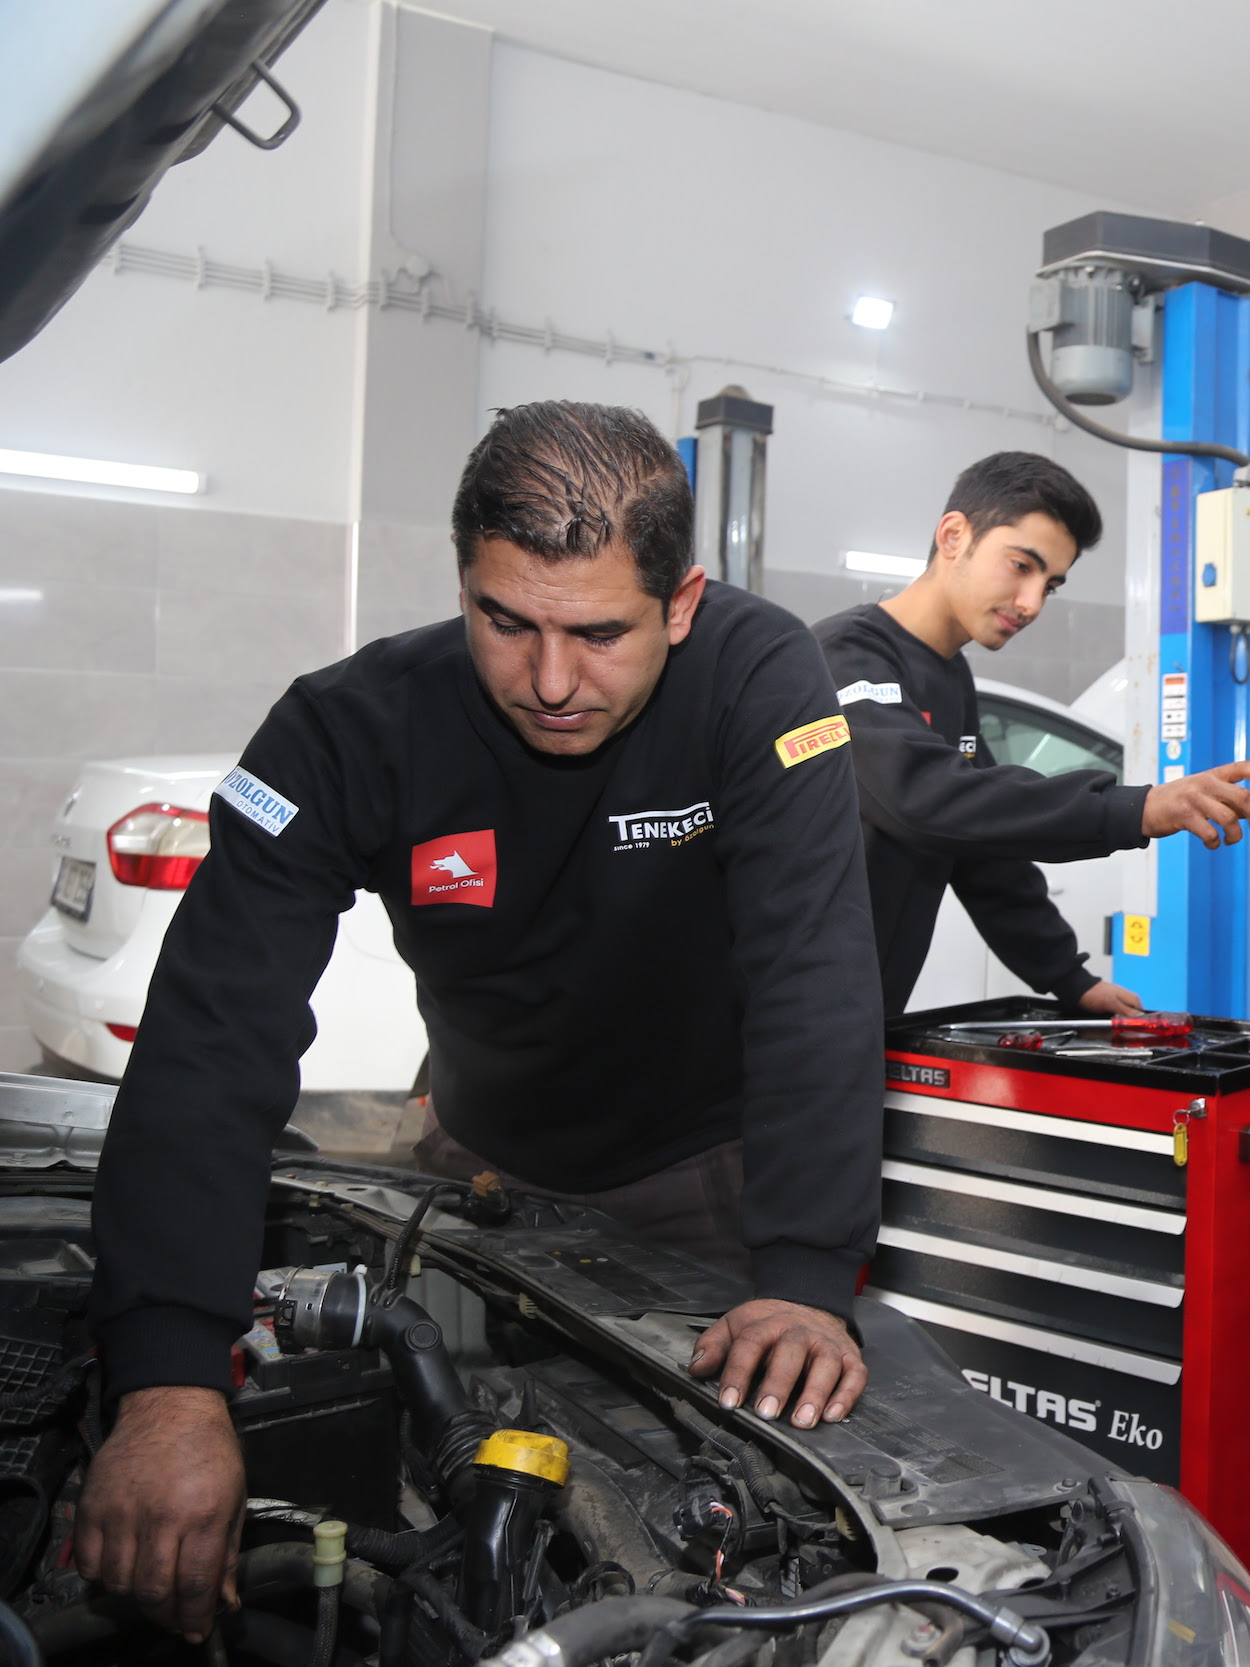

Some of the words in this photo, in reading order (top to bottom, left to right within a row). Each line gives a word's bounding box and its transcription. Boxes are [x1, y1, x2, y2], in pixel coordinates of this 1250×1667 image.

[783, 720, 851, 759] PIRELLI
[613, 843, 633, 852] since
[670, 839, 682, 847] by
[428, 882, 459, 893] Petrol
[460, 878, 484, 887] Ofisi
[961, 1368, 1097, 1432] ELTAS
[1107, 1409, 1163, 1450] Eko
